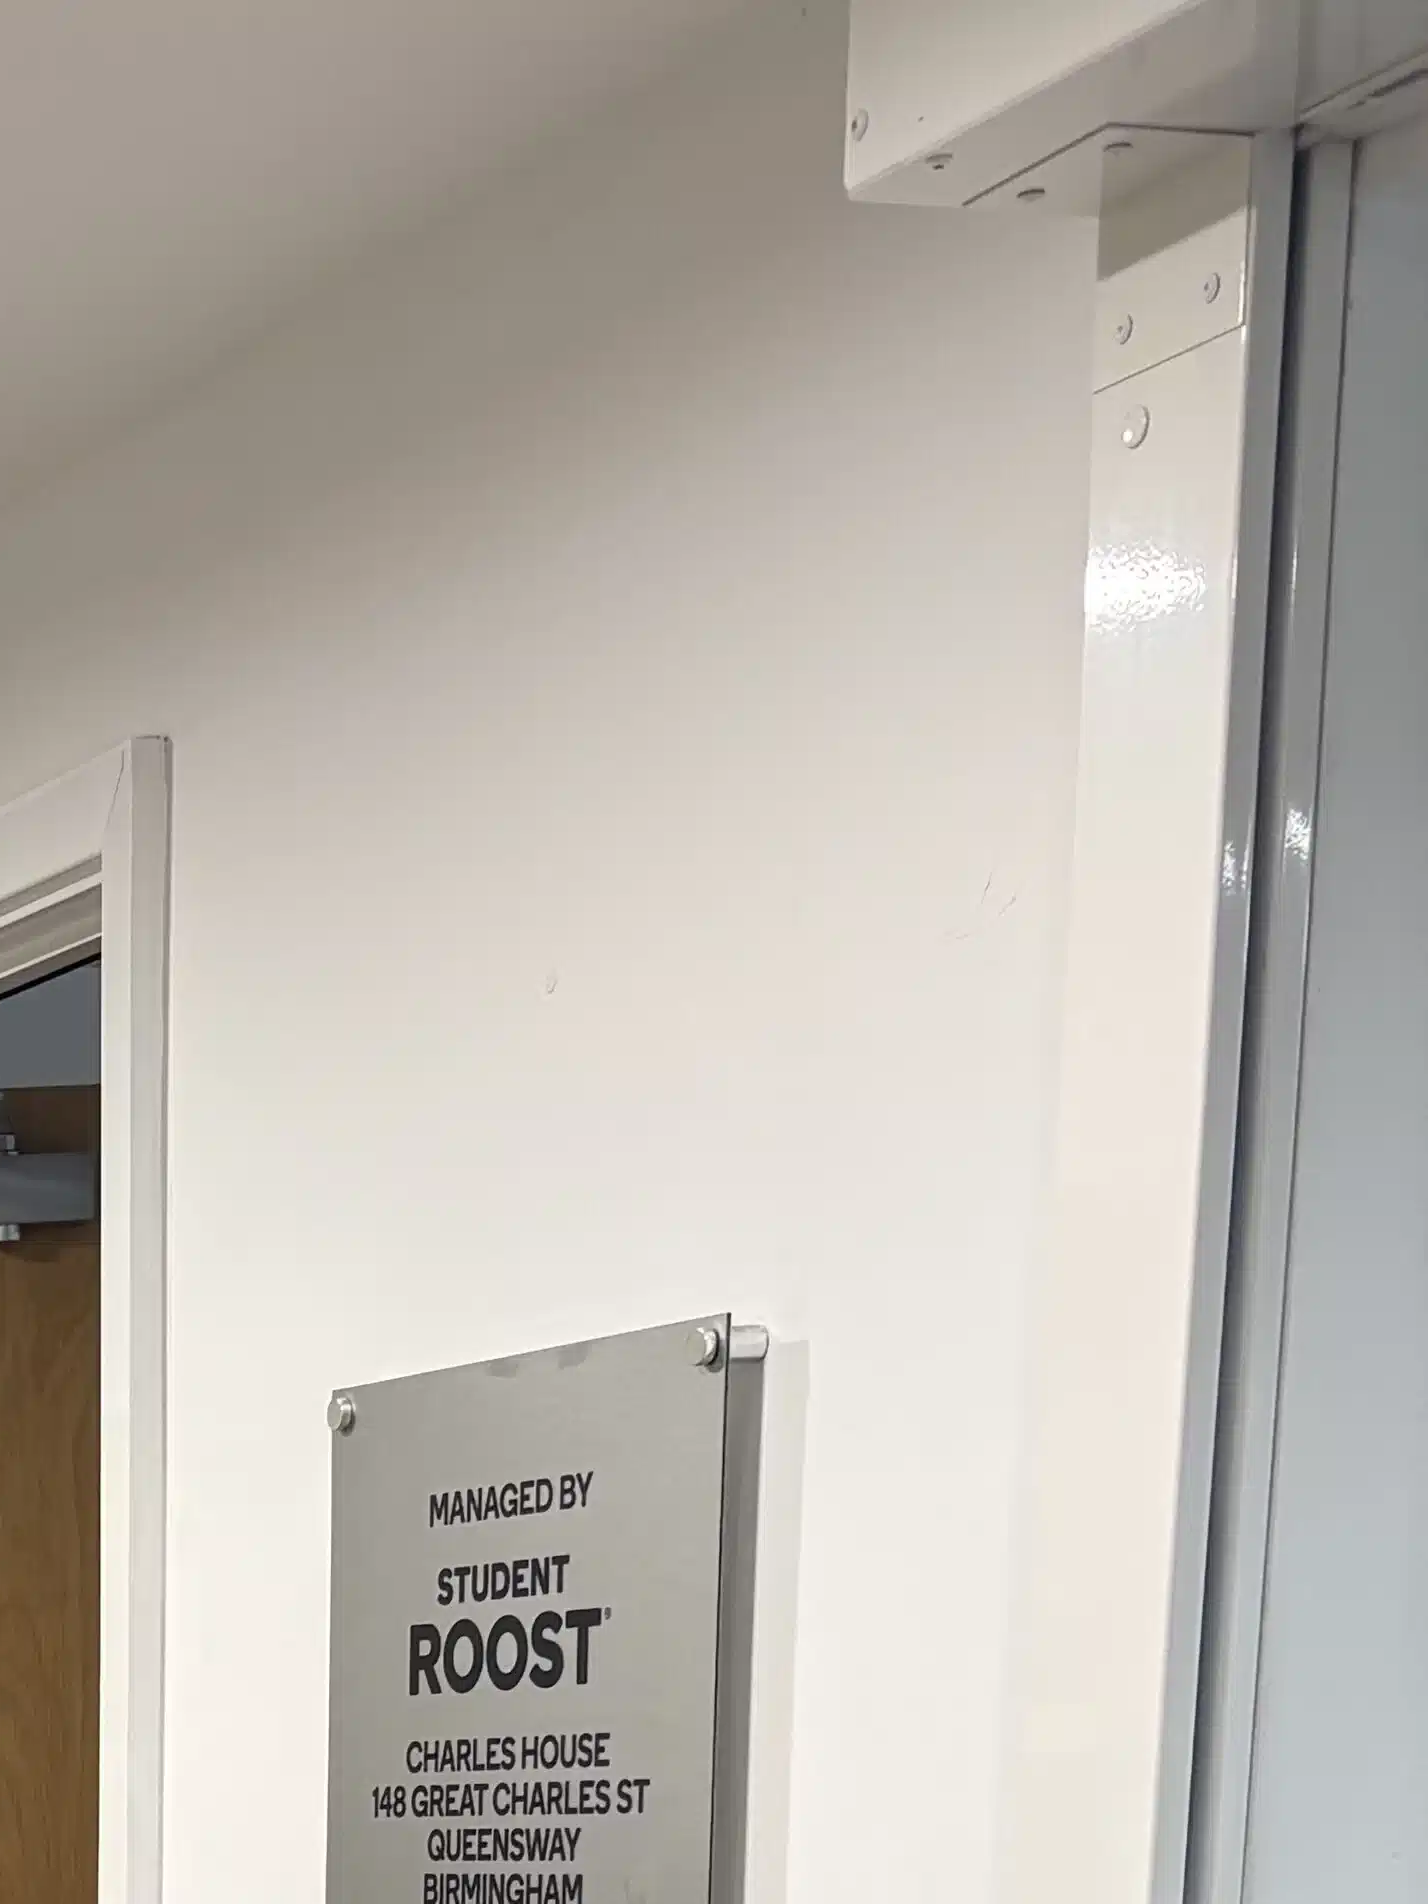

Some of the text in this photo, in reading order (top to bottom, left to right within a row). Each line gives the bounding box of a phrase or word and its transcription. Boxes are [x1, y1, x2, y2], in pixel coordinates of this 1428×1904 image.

[429, 1470, 595, 1528] MANAGED BY
[437, 1553, 571, 1606] STUDENT
[406, 1732, 611, 1773] CHARLES HOUSE
[372, 1778, 651, 1819] 148 GREAT CHARLES ST
[427, 1827, 582, 1862] QUEENSWAY
